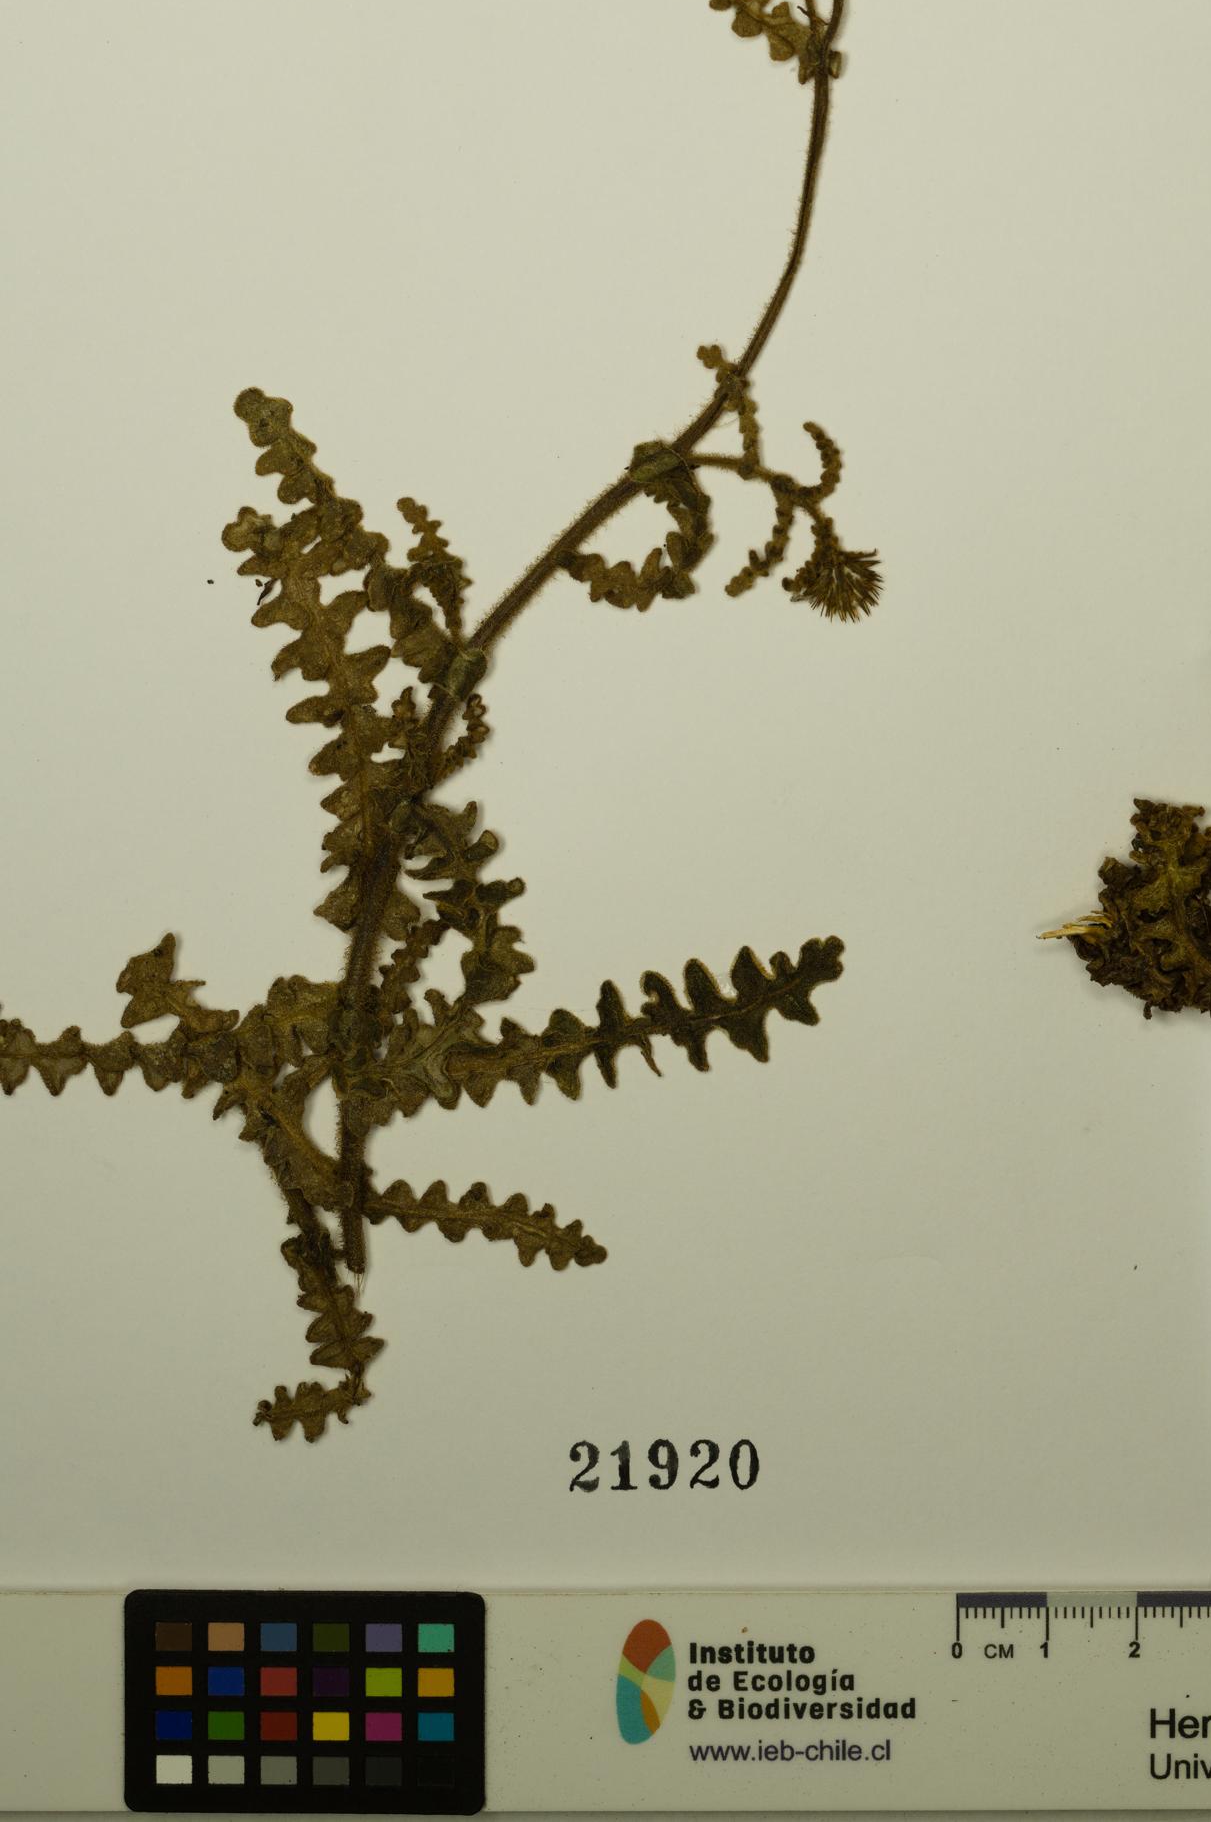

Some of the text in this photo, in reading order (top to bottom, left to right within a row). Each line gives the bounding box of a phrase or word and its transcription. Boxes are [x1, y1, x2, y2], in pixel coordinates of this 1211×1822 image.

[569, 1439, 760, 1493] 21920
[690, 1640, 816, 1665] Instituto
[951, 1643, 963, 1659] 0
[983, 1644, 1015, 1660] CM
[1040, 1642, 1049, 1658] 1
[1128, 1642, 1141, 1658] 2
[688, 1668, 855, 1696] de Ecología
[688, 1697, 916, 1721] & Biodiversidad
[689, 1738, 891, 1762] www.ieb-chile.cl
